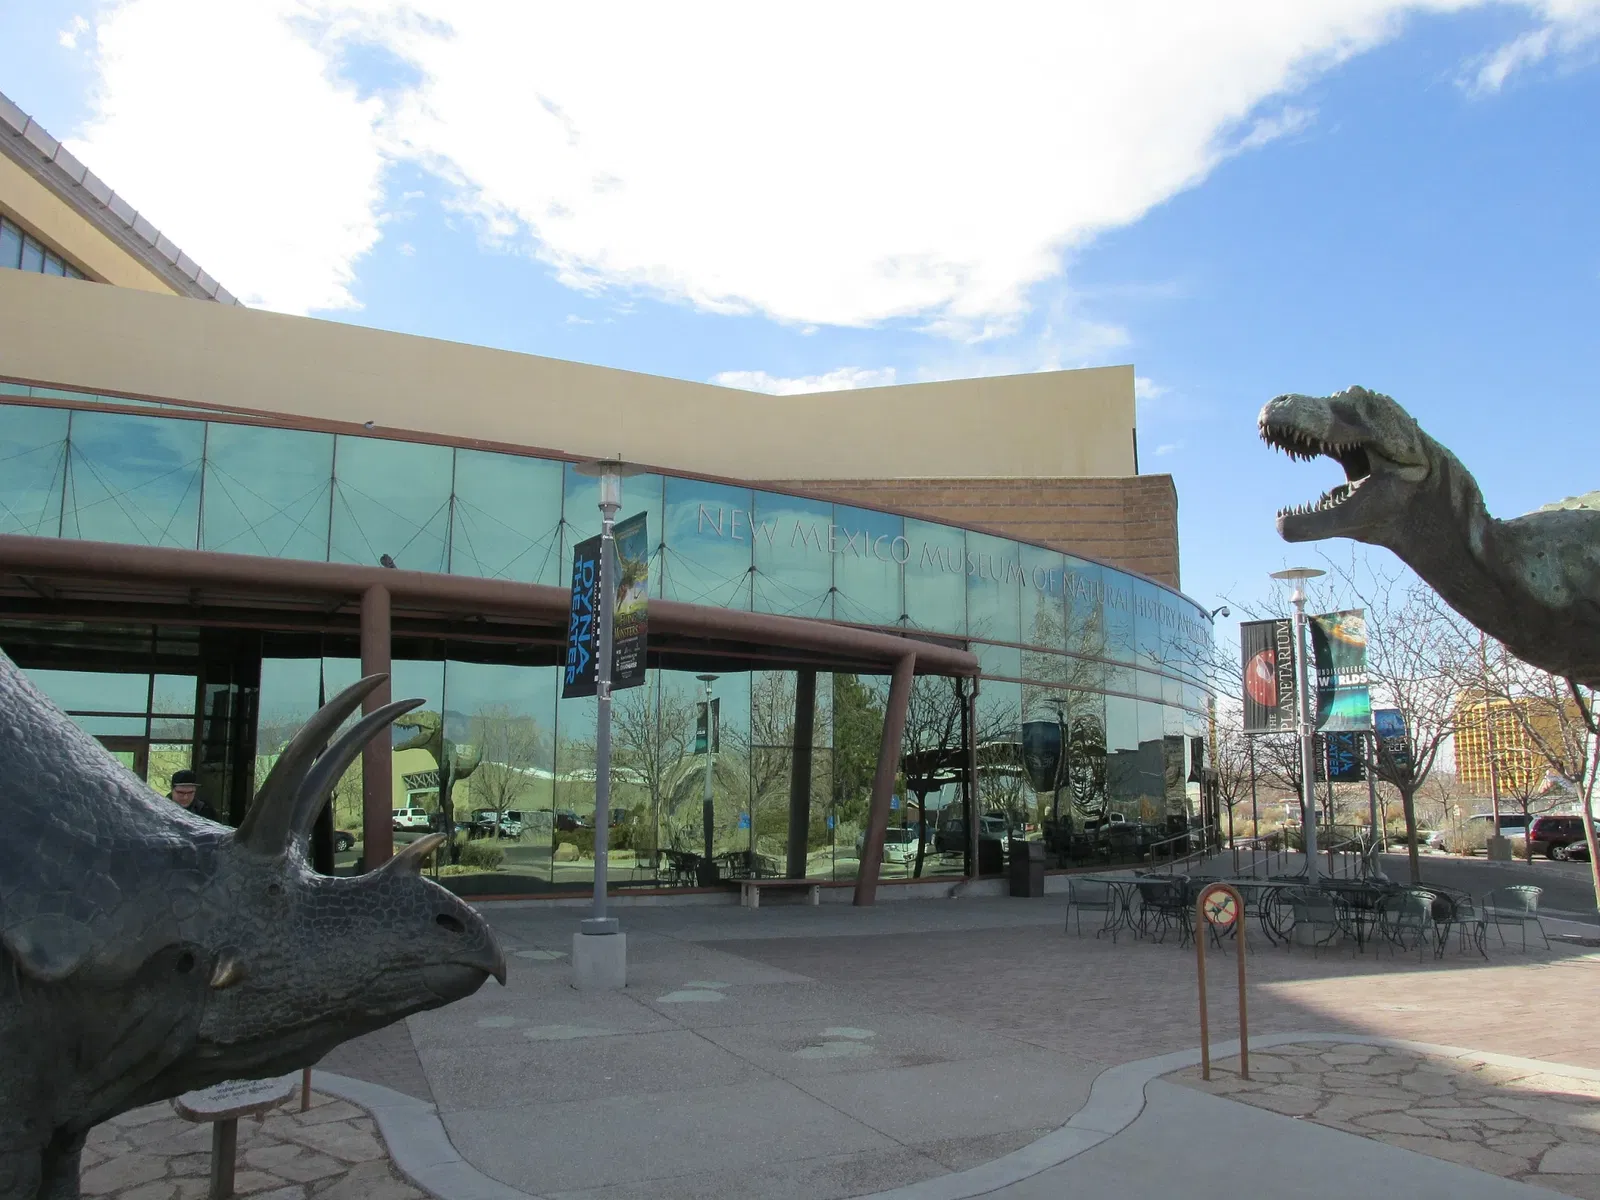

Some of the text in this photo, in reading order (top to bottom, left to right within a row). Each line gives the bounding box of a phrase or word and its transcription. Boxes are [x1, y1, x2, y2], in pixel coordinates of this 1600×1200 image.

[565, 554, 583, 685] THEATER
[576, 559, 595, 674] DYNA
[697, 503, 780, 546] NEW
[791, 520, 911, 564] MEXICO
[920, 542, 1026, 587] MUSEUM
[1032, 565, 1057, 592] OF
[1063, 571, 1129, 612] NATURAL
[1134, 593, 1176, 629] HISTORY
[1269, 713, 1277, 732] THE
[1277, 620, 1293, 732] PLANETARIUM
[1317, 664, 1367, 677] UNDISCOVERED
